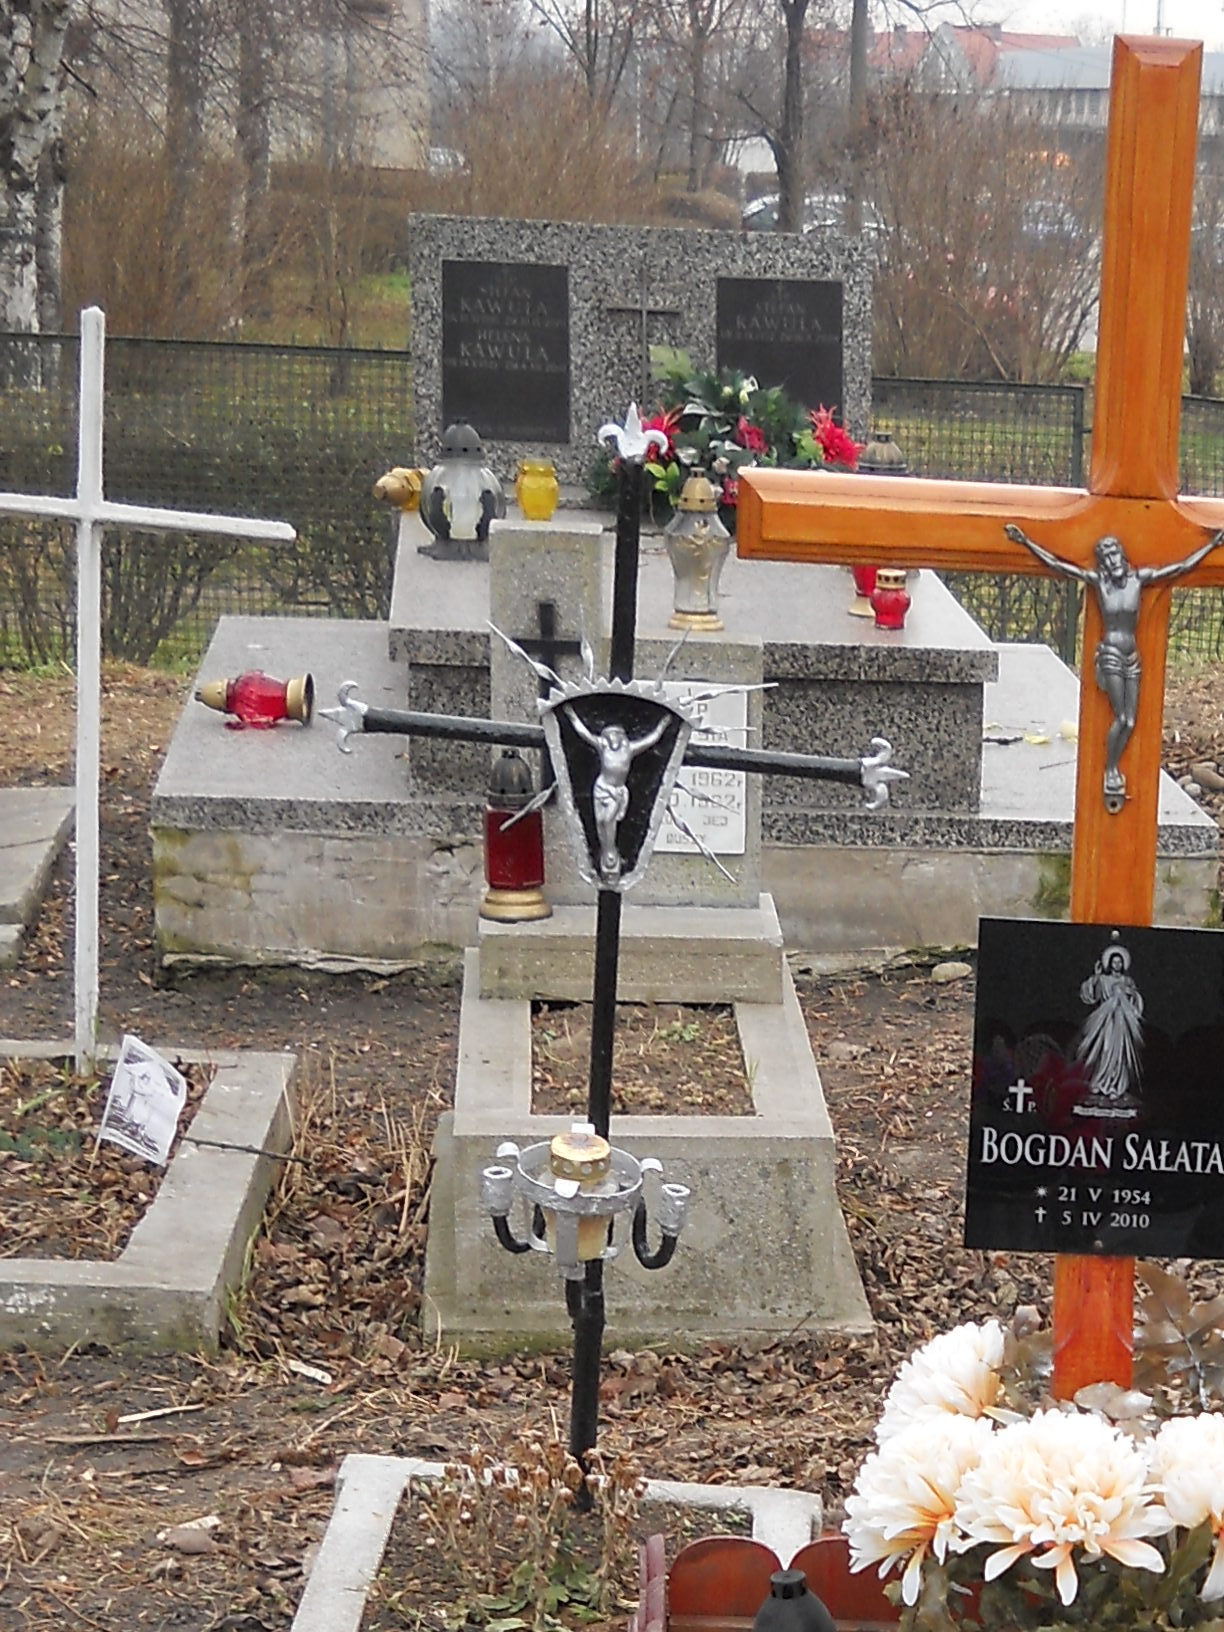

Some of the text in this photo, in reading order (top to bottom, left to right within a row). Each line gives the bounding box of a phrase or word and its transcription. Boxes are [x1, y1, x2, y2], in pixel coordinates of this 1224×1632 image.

[980, 1126, 1114, 1169] BOGDAN
[1057, 1186, 1151, 1206] 21 V 1954
[1060, 1210, 1150, 1229] 5 IV 2010
